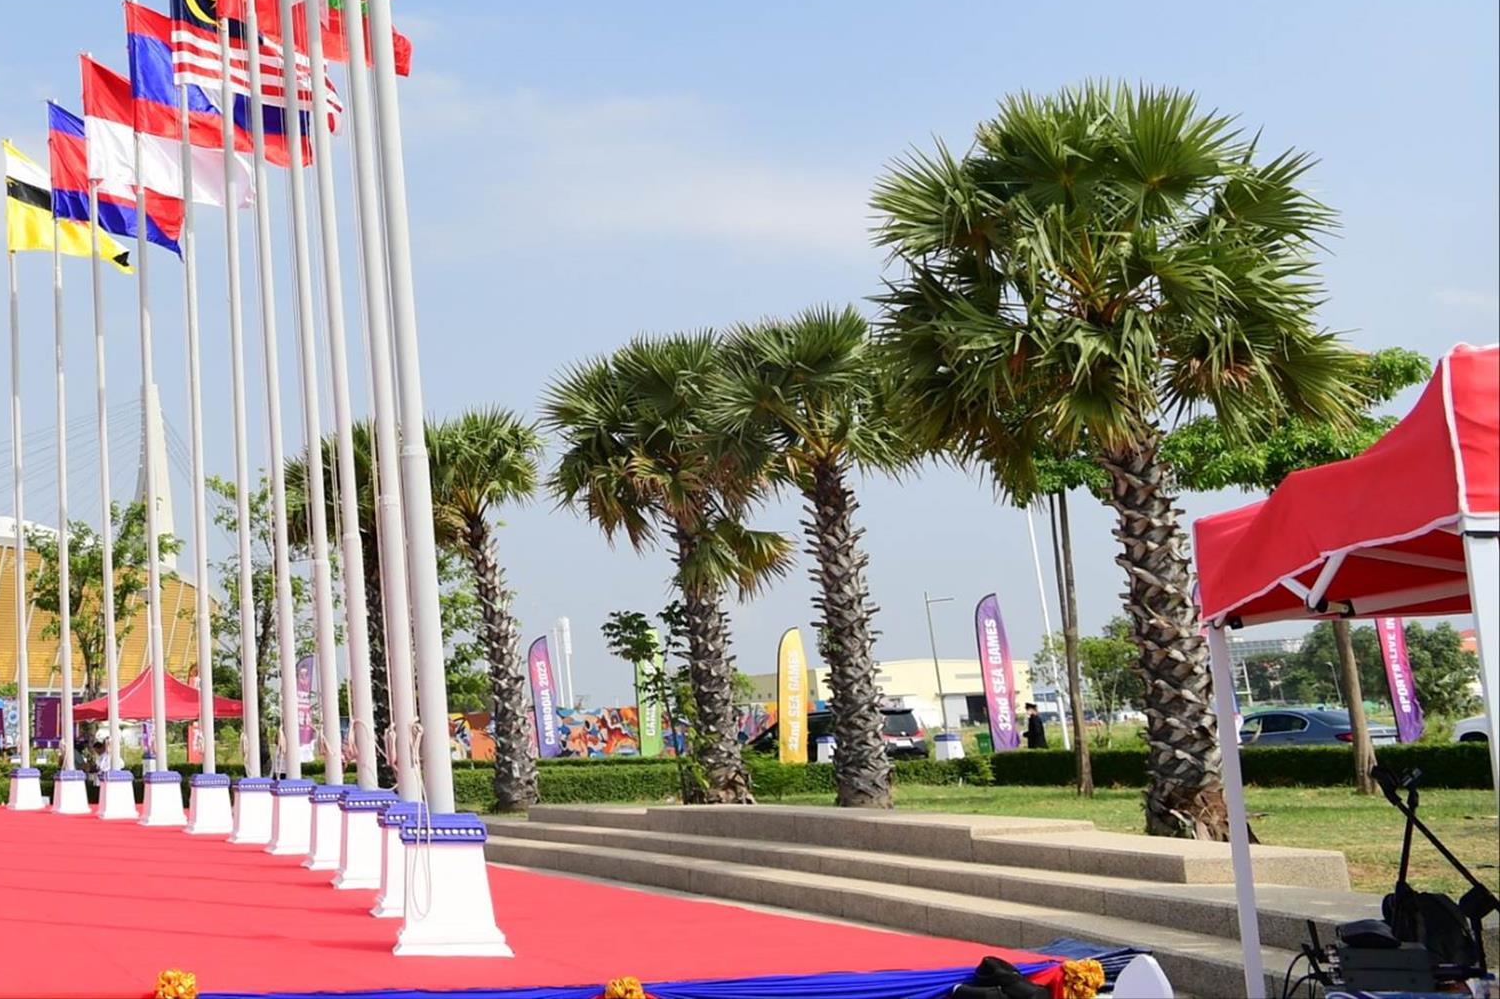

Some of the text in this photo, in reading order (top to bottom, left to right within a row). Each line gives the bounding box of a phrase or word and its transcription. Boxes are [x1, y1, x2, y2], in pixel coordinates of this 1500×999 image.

[536, 661, 555, 745] CAMBODIA 2023
[787, 695, 800, 717] SEA
[984, 618, 1012, 732] 32nd SEA GAMES
